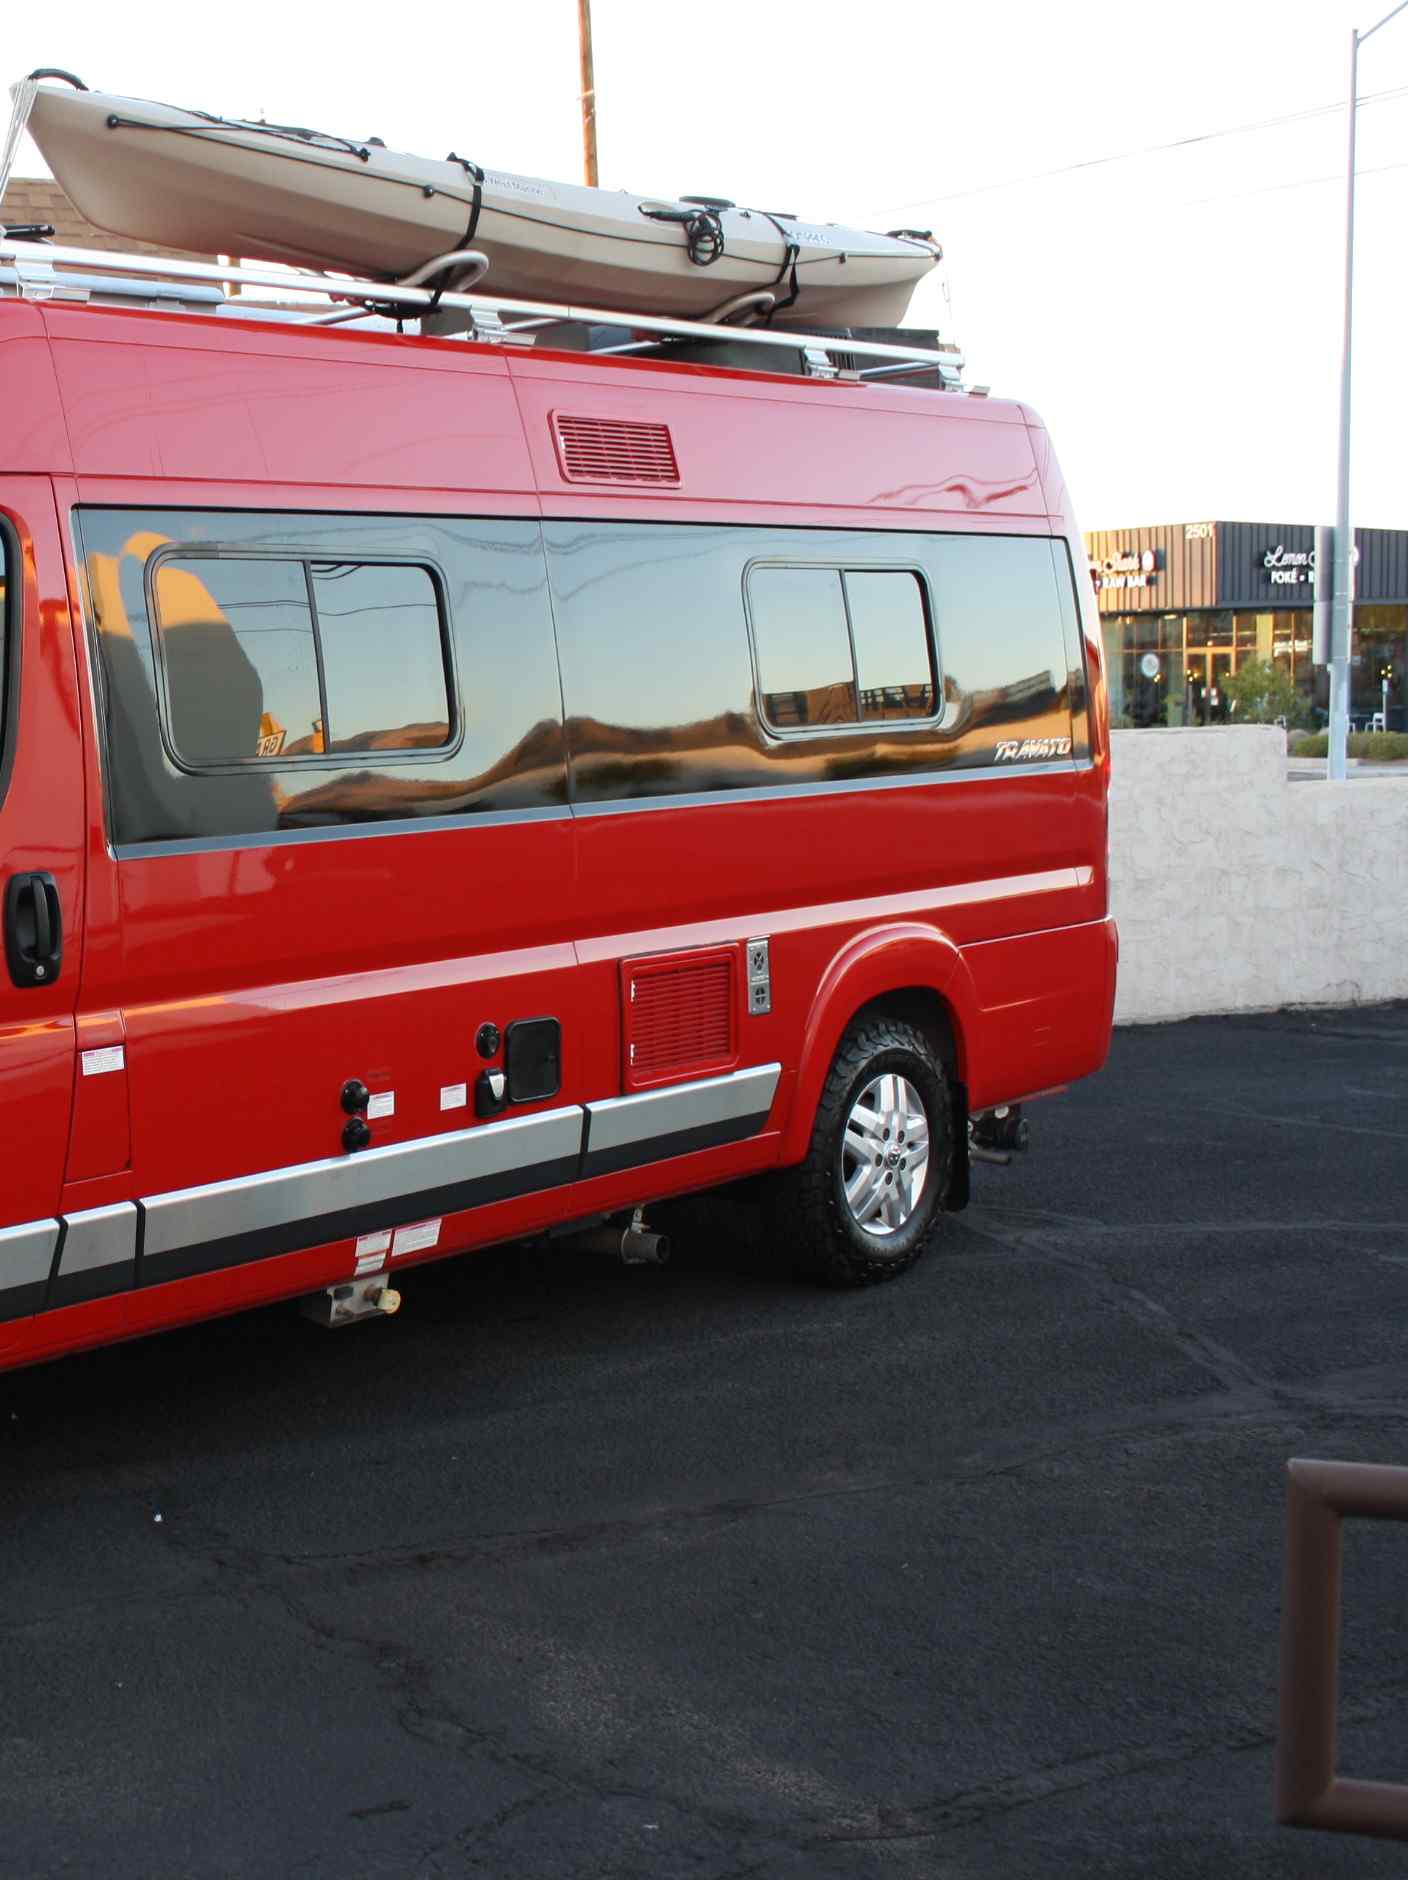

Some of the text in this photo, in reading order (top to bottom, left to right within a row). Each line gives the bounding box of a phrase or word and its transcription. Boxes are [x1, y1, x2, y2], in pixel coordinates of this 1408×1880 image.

[1185, 523, 1213, 539] 2501
[1264, 544, 1307, 568] Lemon
[1102, 575, 1147, 588] RAW BAR
[1271, 567, 1297, 584] POKÉ
[994, 736, 1072, 761] TRAVATO
